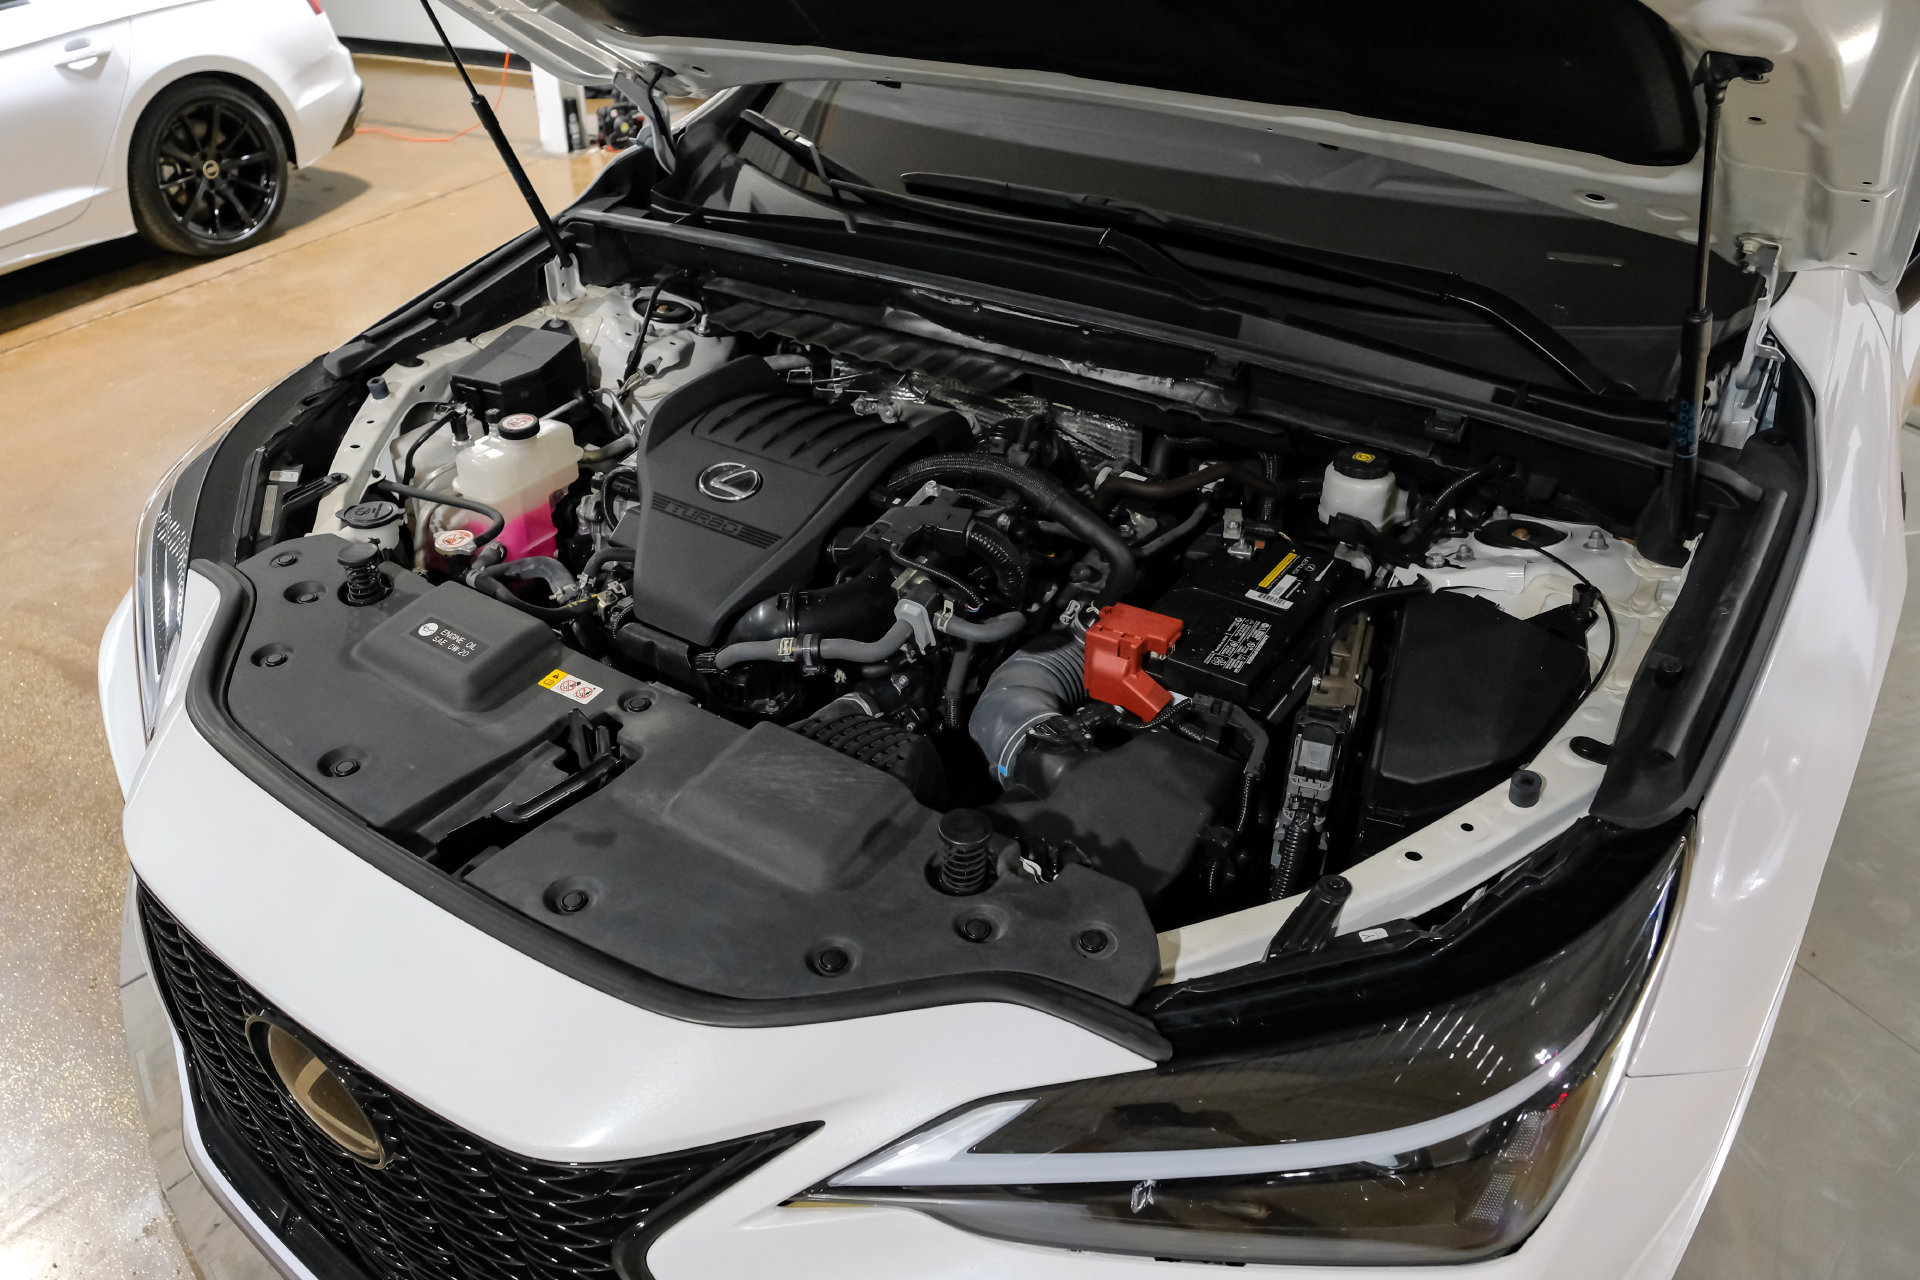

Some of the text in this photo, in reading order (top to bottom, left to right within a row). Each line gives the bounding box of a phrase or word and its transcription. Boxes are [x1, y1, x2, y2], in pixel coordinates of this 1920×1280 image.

[667, 502, 741, 535] TURBO
[432, 635, 470, 657] SAE 0W-20
[440, 629, 477, 651] ENGINE OIL
